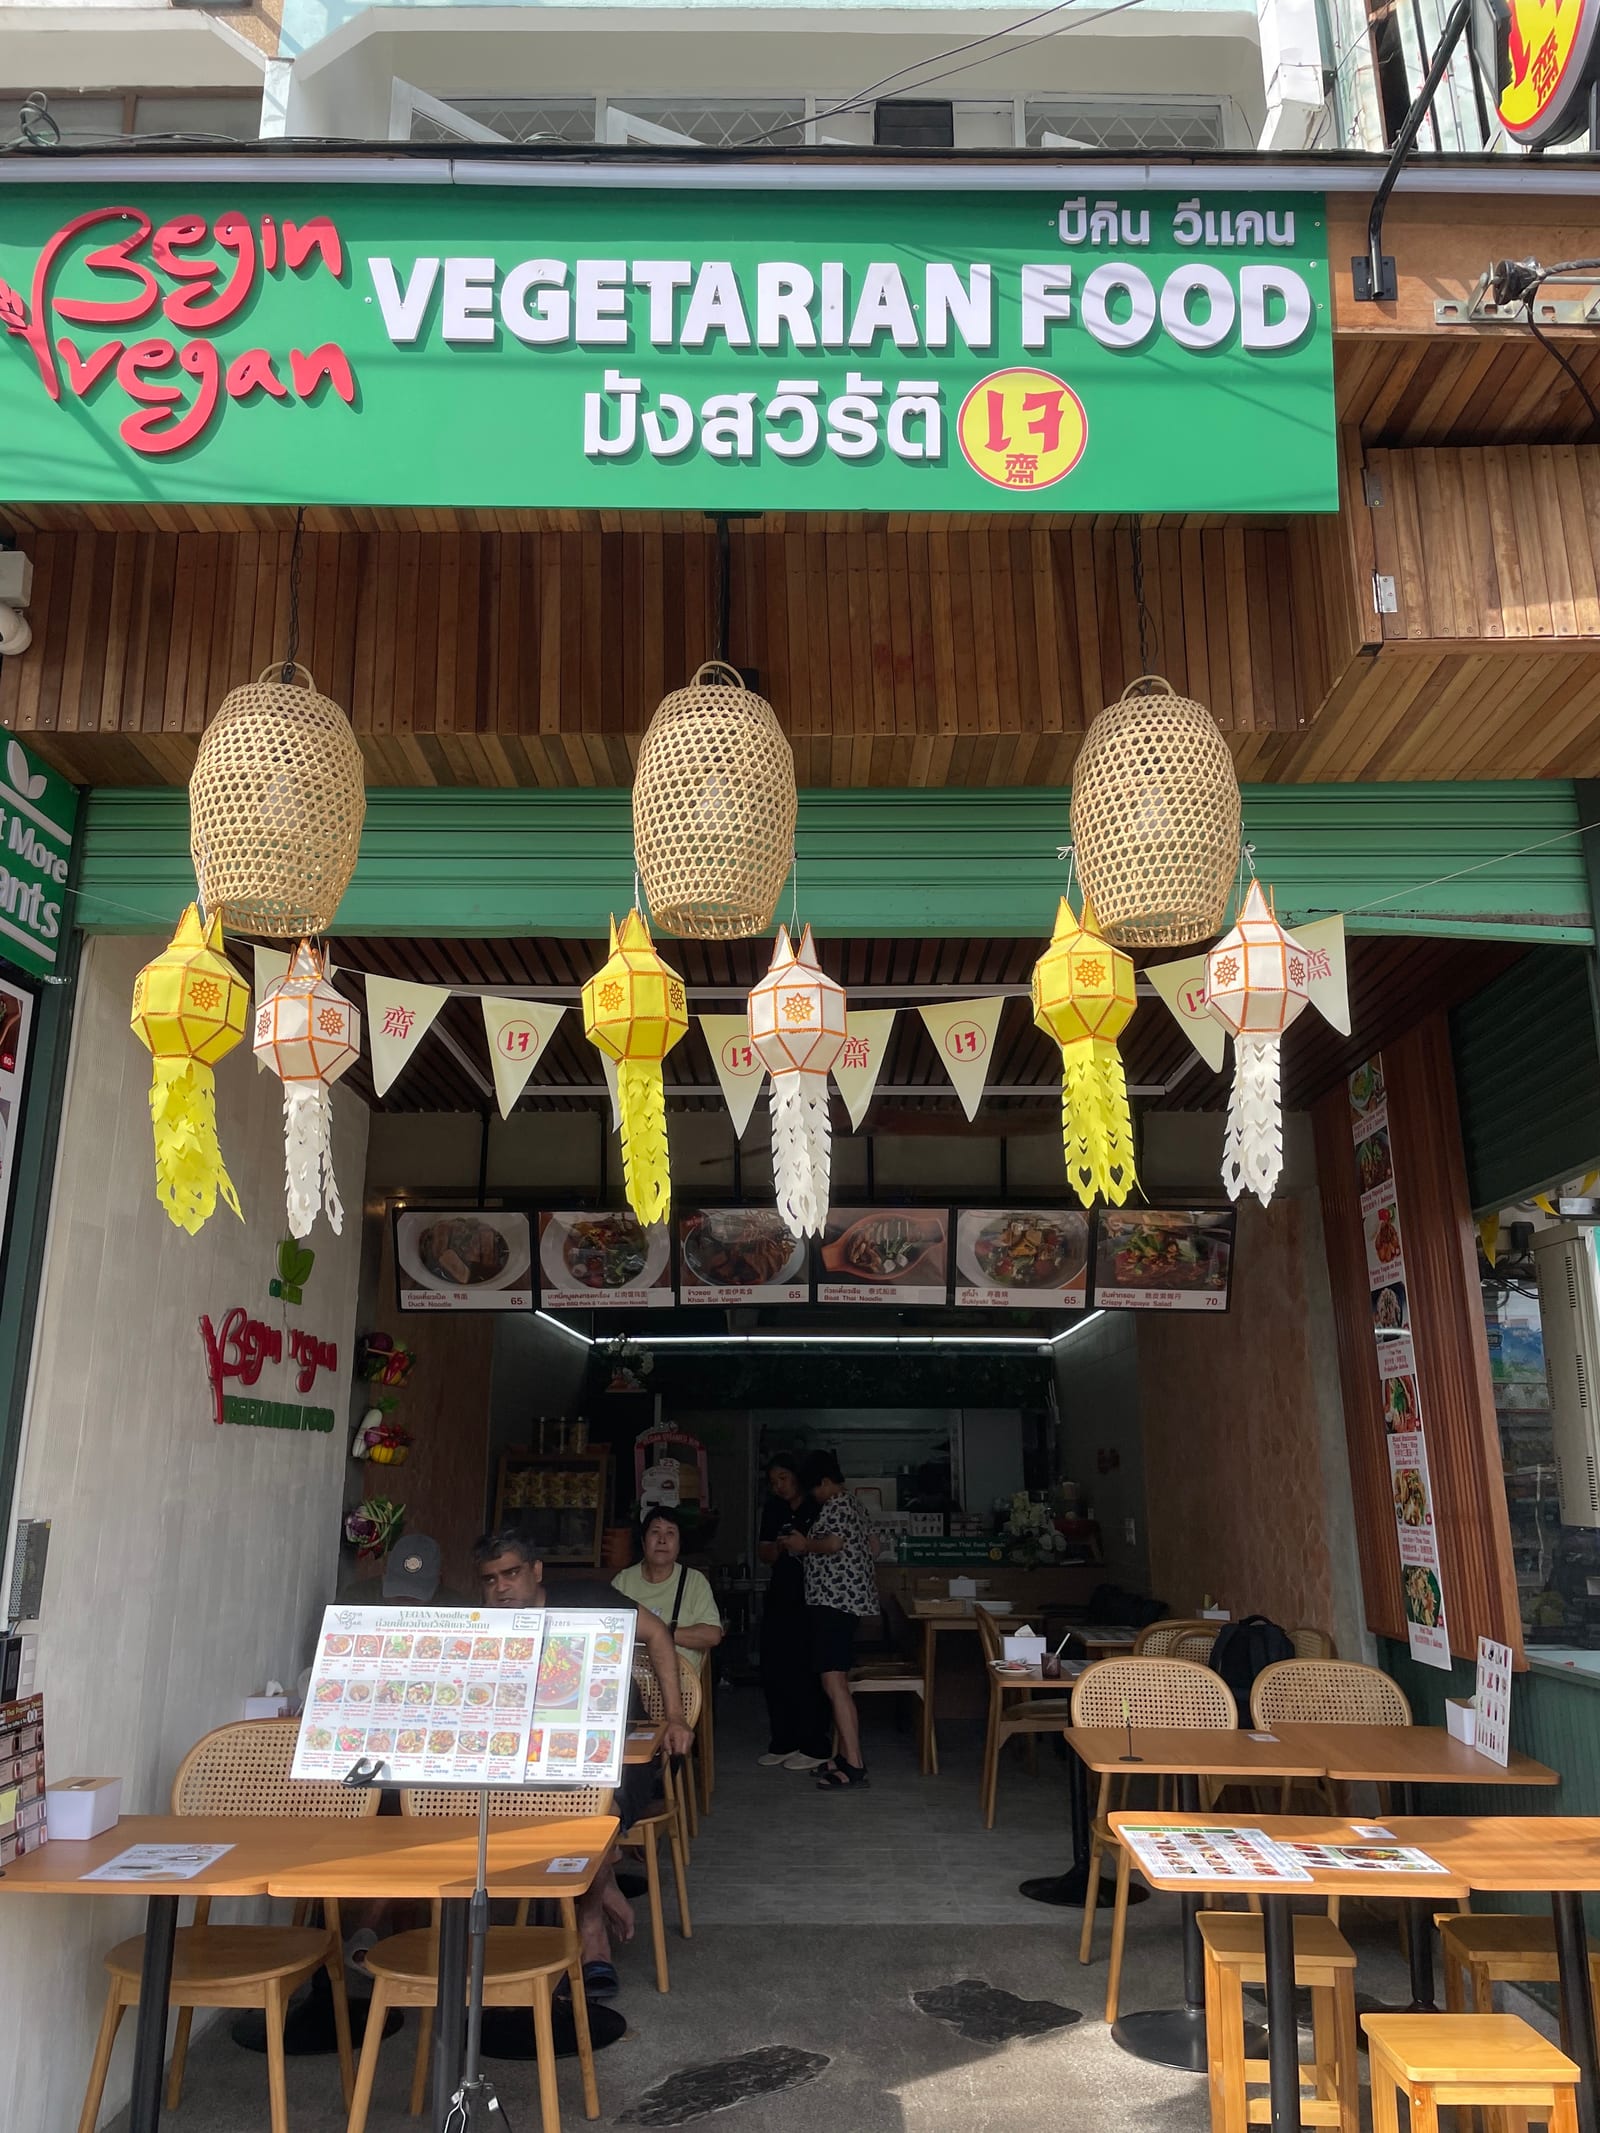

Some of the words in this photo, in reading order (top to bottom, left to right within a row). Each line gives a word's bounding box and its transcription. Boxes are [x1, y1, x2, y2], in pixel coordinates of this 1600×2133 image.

[33, 205, 343, 330] Begin
[367, 257, 991, 348] VEGETARIAN
[1021, 261, 1311, 350] FOOD
[57, 338, 355, 452] vegan
[583, 369, 941, 459] มังสวิรัติ
[983, 389, 1065, 454] เจ
[8, 816, 68, 884] More
